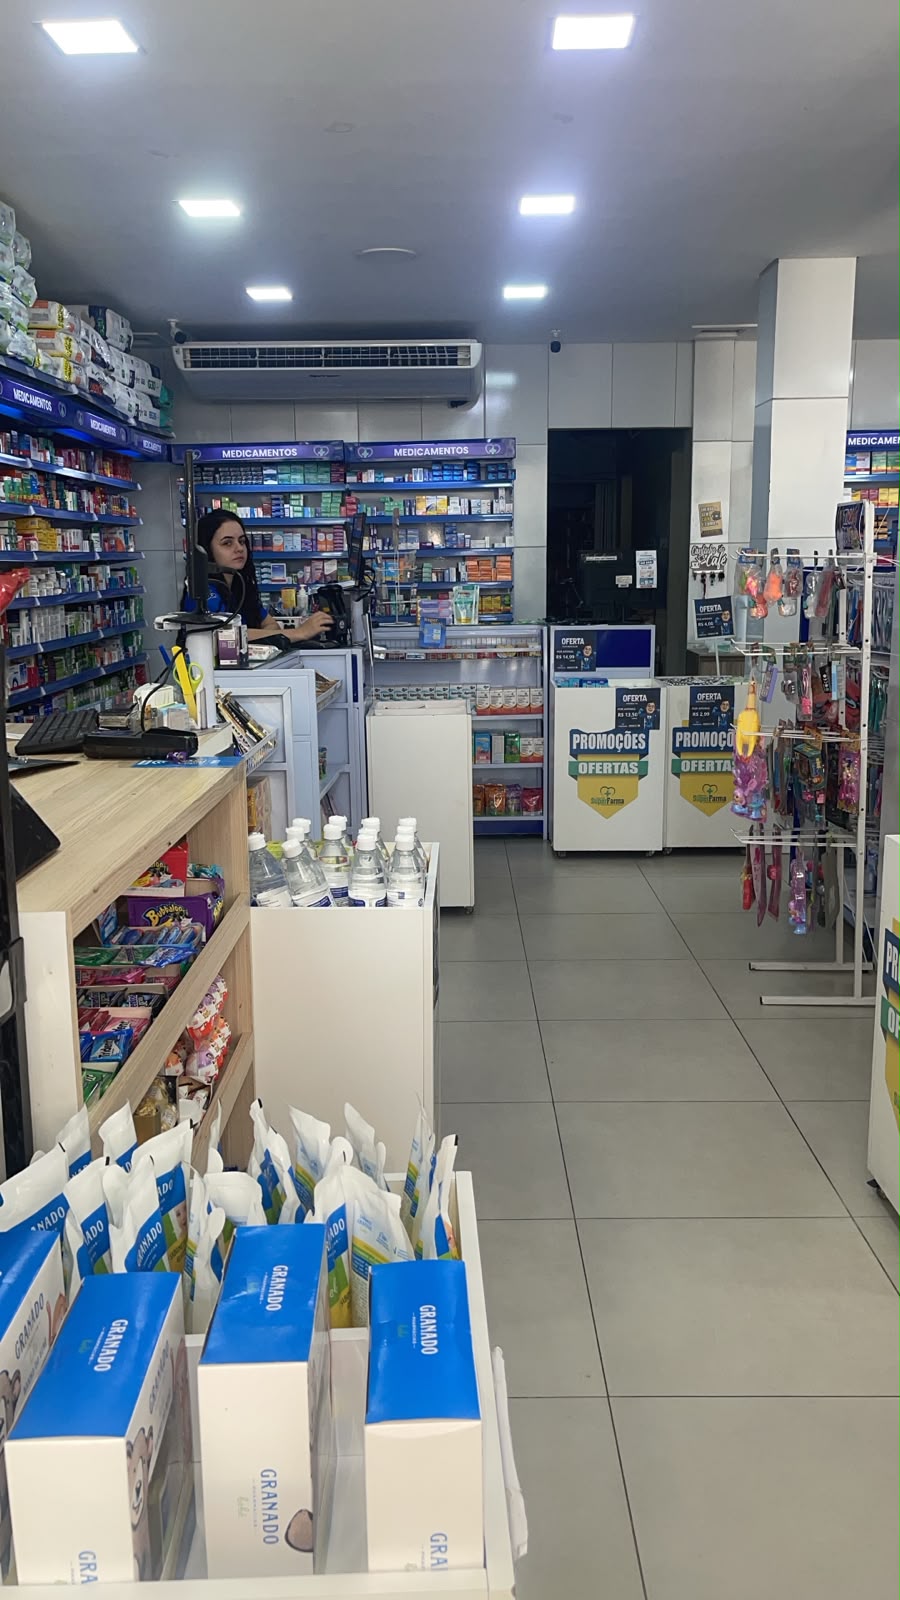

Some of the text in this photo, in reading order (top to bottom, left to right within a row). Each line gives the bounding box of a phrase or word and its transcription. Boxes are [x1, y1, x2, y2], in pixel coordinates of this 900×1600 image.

[13, 388, 53, 412] MEDICAMENTOS
[222, 448, 298, 459] MEDICAMENTOS
[394, 446, 469, 457] MEDICAMENTOS
[699, 604, 722, 613] OFERTA
[561, 637, 585, 645] OFERTA
[622, 694, 648, 702] OFERTA
[697, 693, 722, 701] OFERTA
[572, 731, 646, 753] PROMOÇÕES
[675, 728, 735, 751] PROMOÇÕ
[578, 762, 639, 775] OFERTAS
[266, 1265, 288, 1311] GRANADO
[14, 1292, 45, 1360] GRANADO
[419, 1304, 438, 1354] GRANADO
[94, 1319, 128, 1371] GRANADO
[260, 1468, 279, 1545] GRANADO
[78, 1550, 99, 1585] GRA
